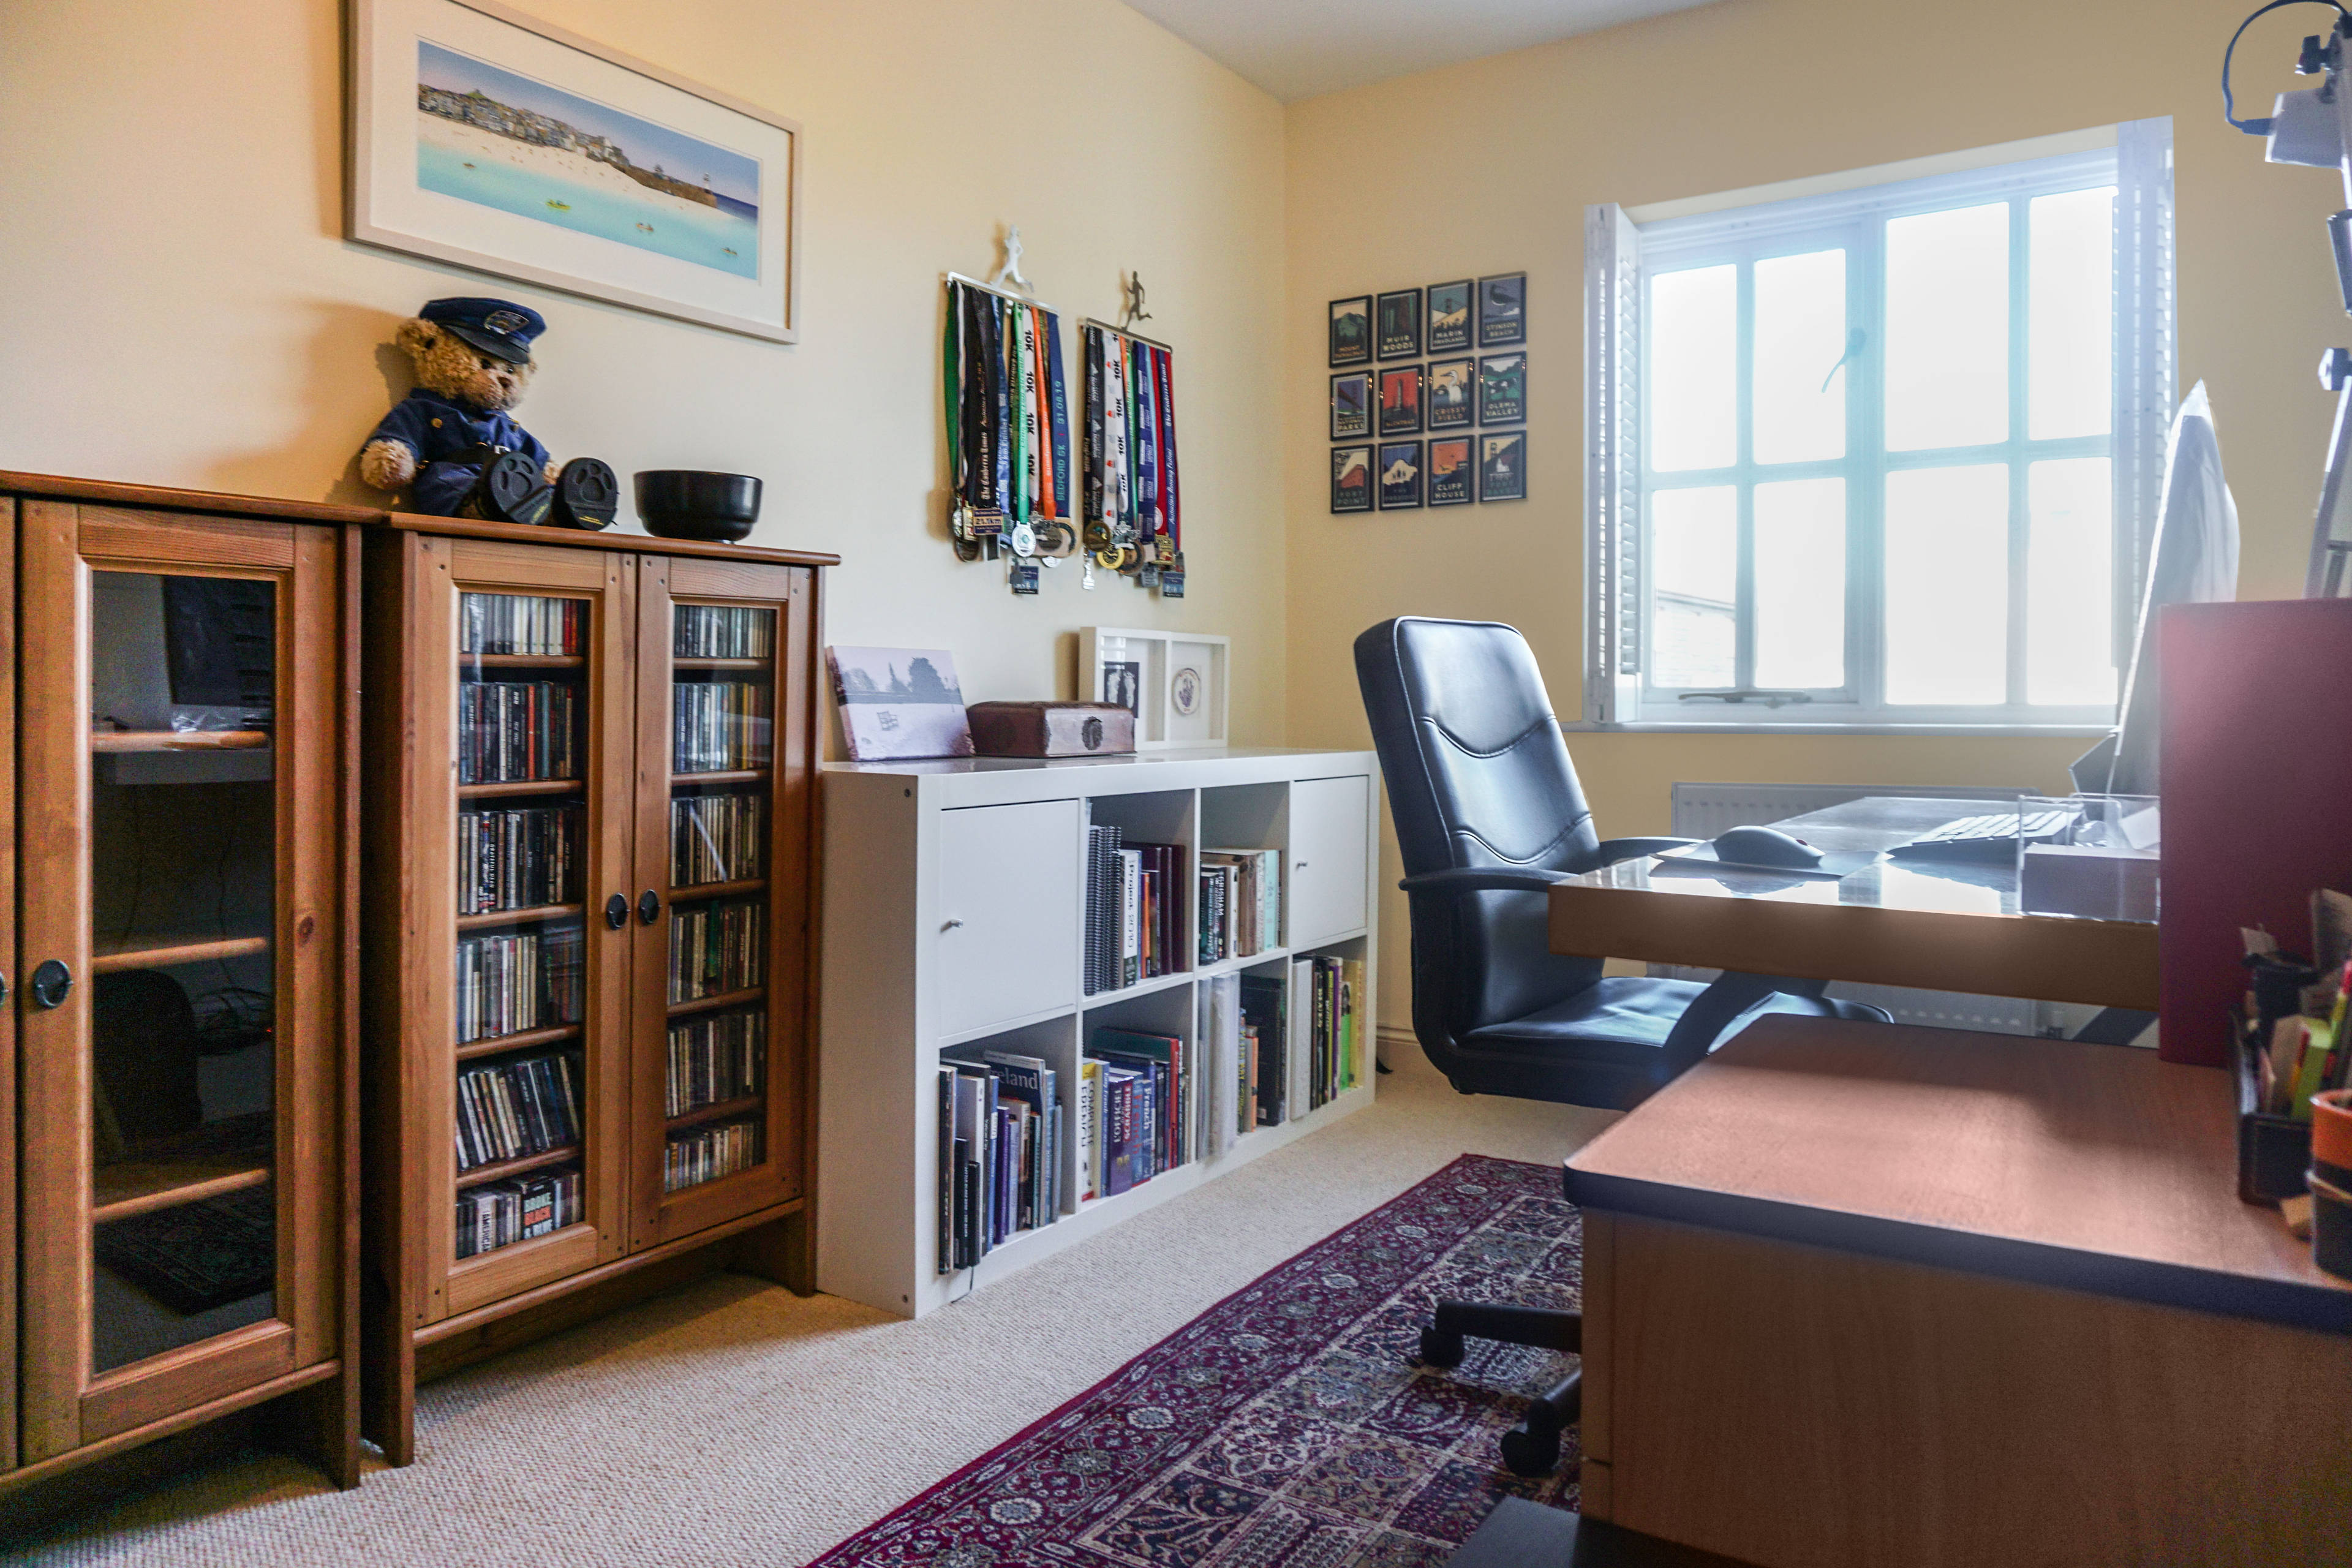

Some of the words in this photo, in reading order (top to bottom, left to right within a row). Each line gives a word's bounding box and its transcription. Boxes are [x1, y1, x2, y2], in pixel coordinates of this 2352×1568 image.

[1025, 330, 1035, 351] 10K
[1383, 341, 1414, 352] WOODS
[1386, 334, 1410, 344] MUIR
[1026, 371, 1035, 392] 10K
[1487, 407, 1518, 417] VALLEY
[1488, 401, 1517, 410] OLEMA
[1027, 412, 1035, 434] 10K
[980, 431, 989, 453] Times
[981, 455, 990, 486] Canberra
[1057, 459, 1066, 500] BEDFORD
[981, 486, 990, 500] The
[1434, 490, 1464, 499] HOUSE
[1436, 483, 1463, 491] CLIFF
[990, 1066, 1039, 1090] eland
[1143, 1087, 1152, 1130] French
